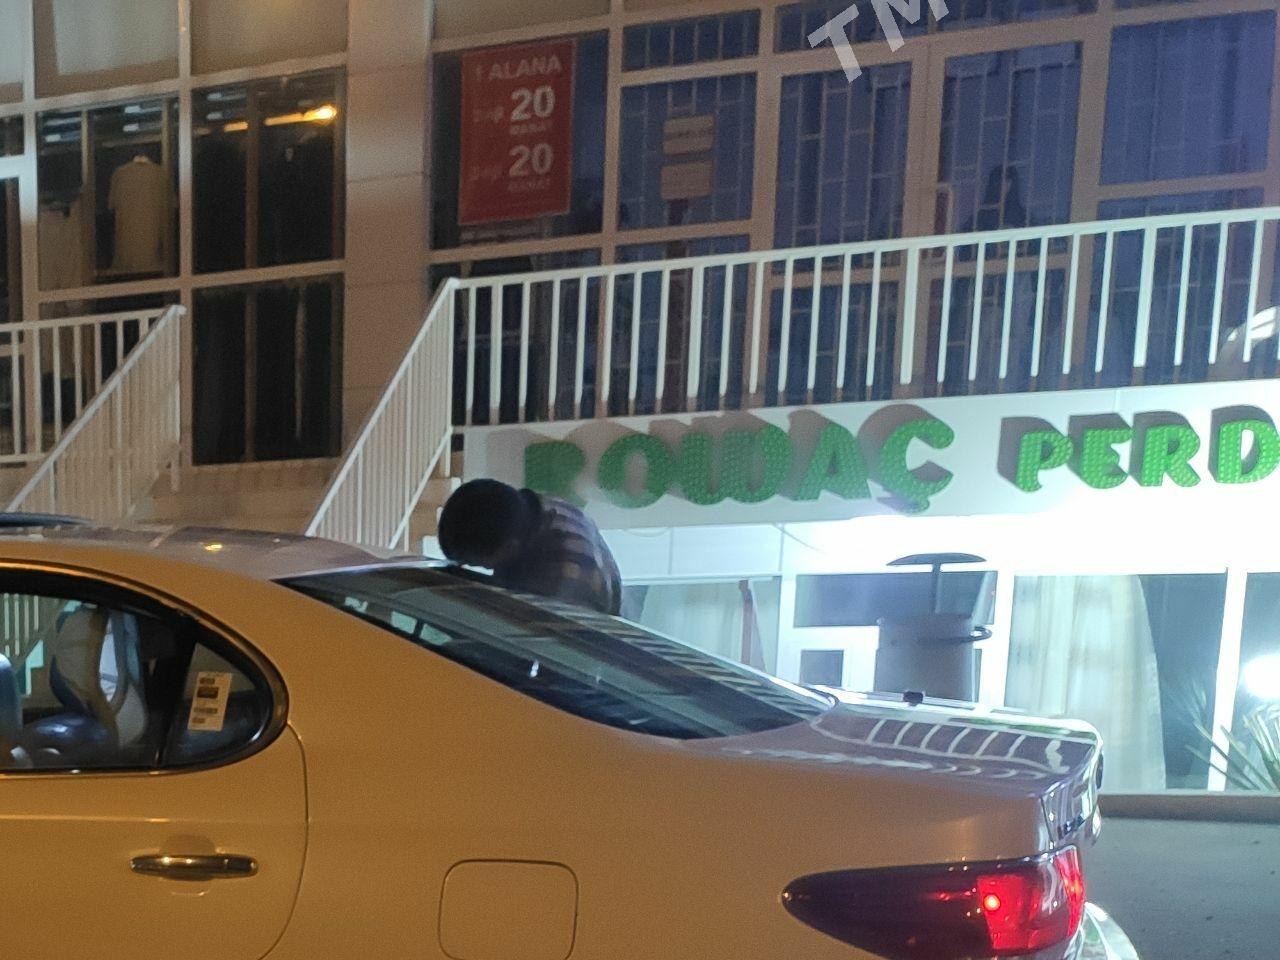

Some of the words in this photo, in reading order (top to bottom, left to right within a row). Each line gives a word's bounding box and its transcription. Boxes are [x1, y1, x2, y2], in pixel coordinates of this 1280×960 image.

[488, 54, 563, 80] ALANA
[510, 85, 556, 121] 20
[508, 143, 554, 177] 20
[1005, 408, 1280, 492] PERD
